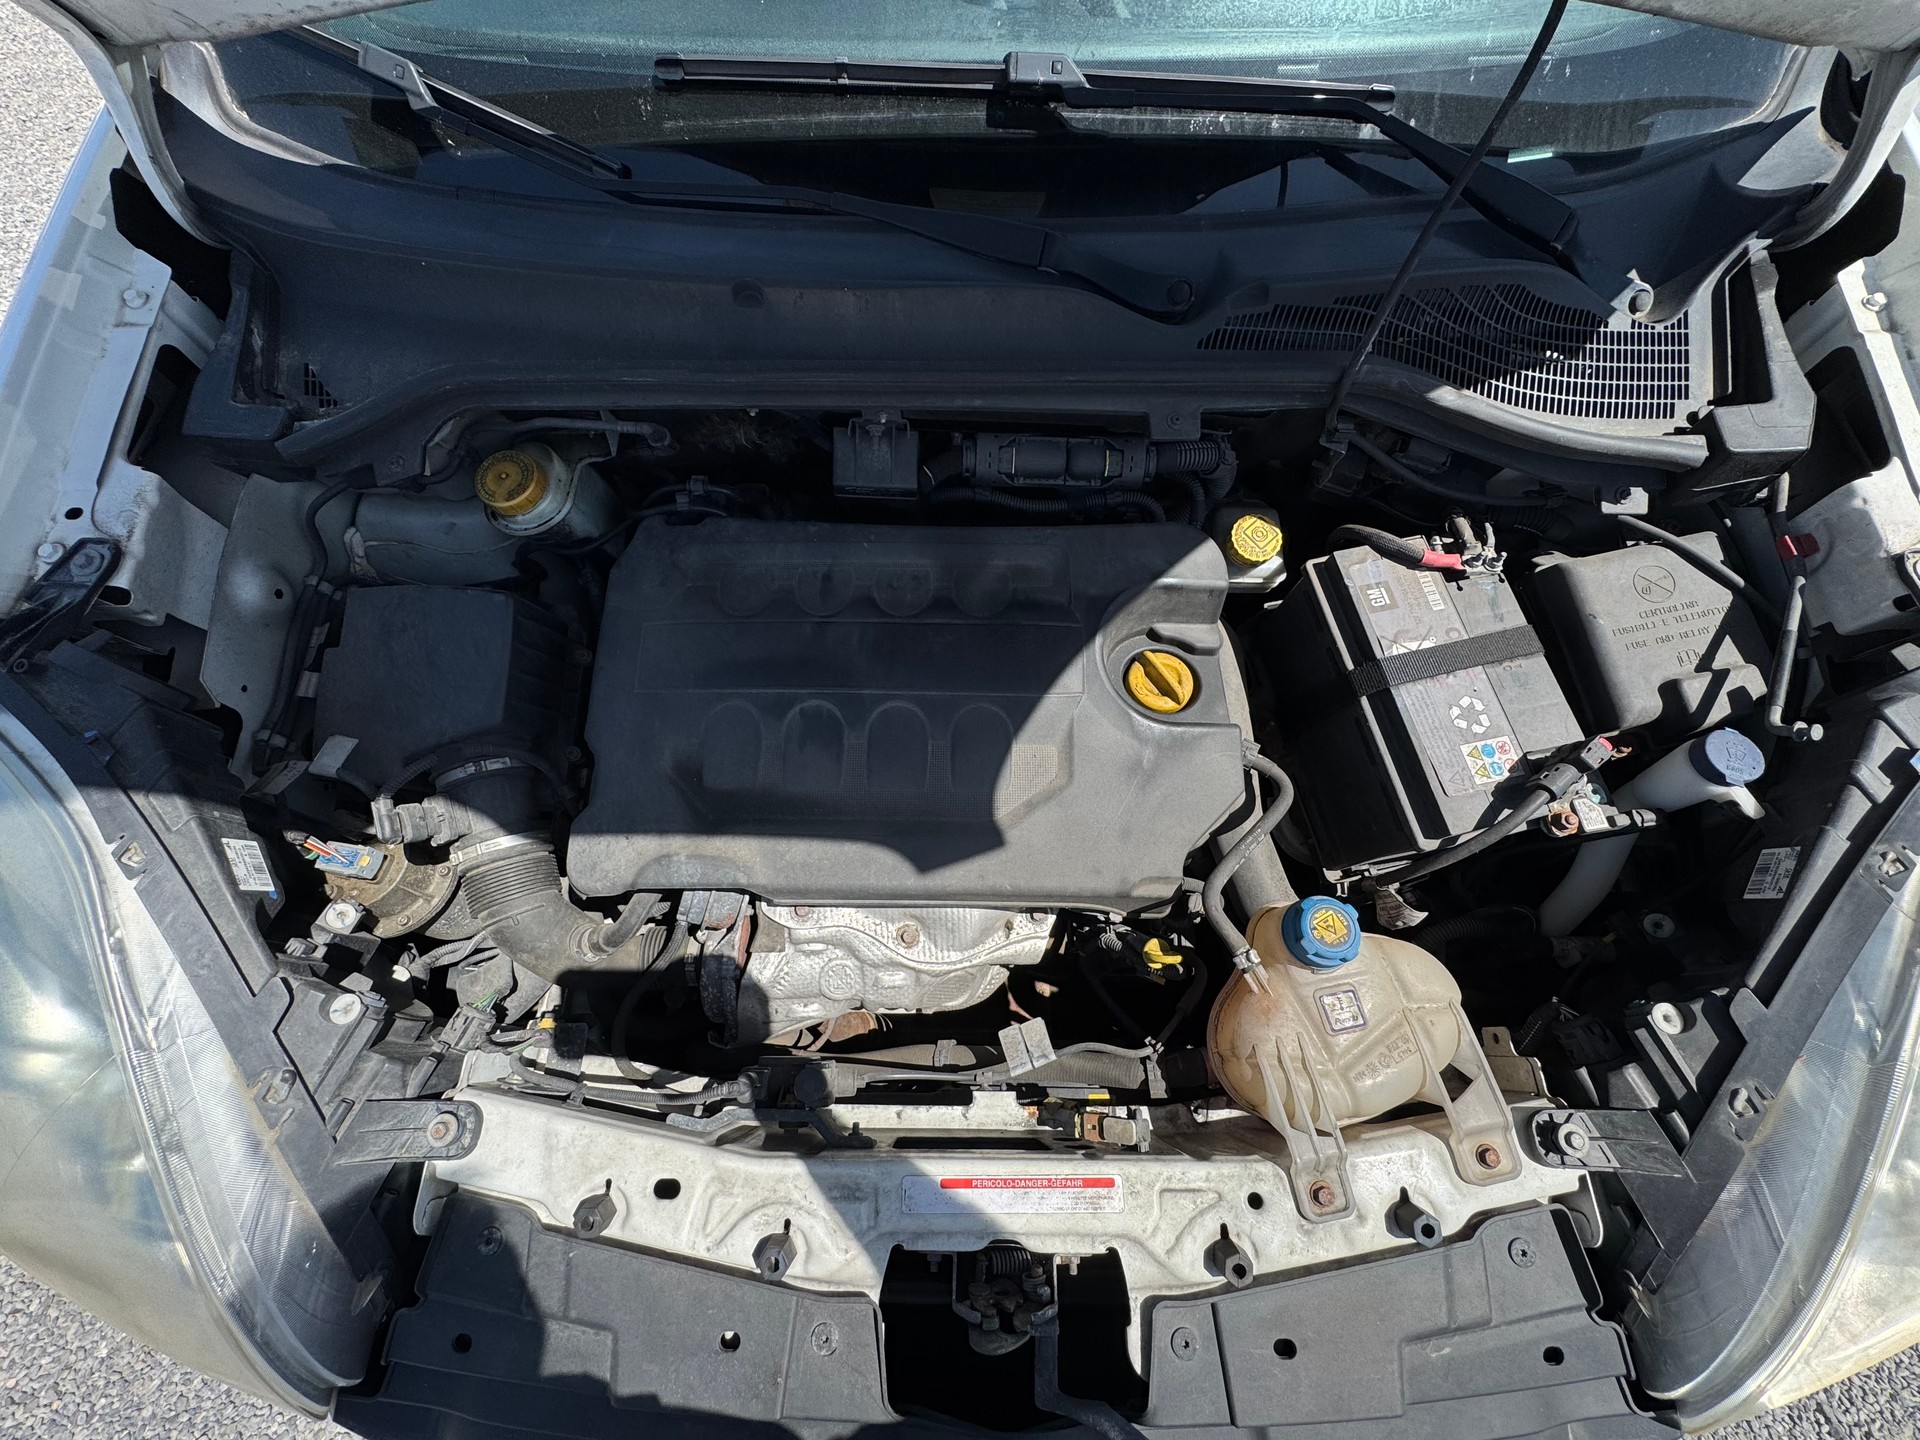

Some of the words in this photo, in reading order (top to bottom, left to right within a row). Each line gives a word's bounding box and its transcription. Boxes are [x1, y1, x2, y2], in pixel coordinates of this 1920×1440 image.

[1366, 587, 1386, 607] GM
[1639, 600, 1699, 619] CENTRALINA
[1625, 639, 1651, 651] FUSE
[1655, 633, 1675, 646] AND
[1679, 626, 1711, 640] RELAY
[972, 1179, 1083, 1188] PERICOLO-DANGER-GEFAHR
